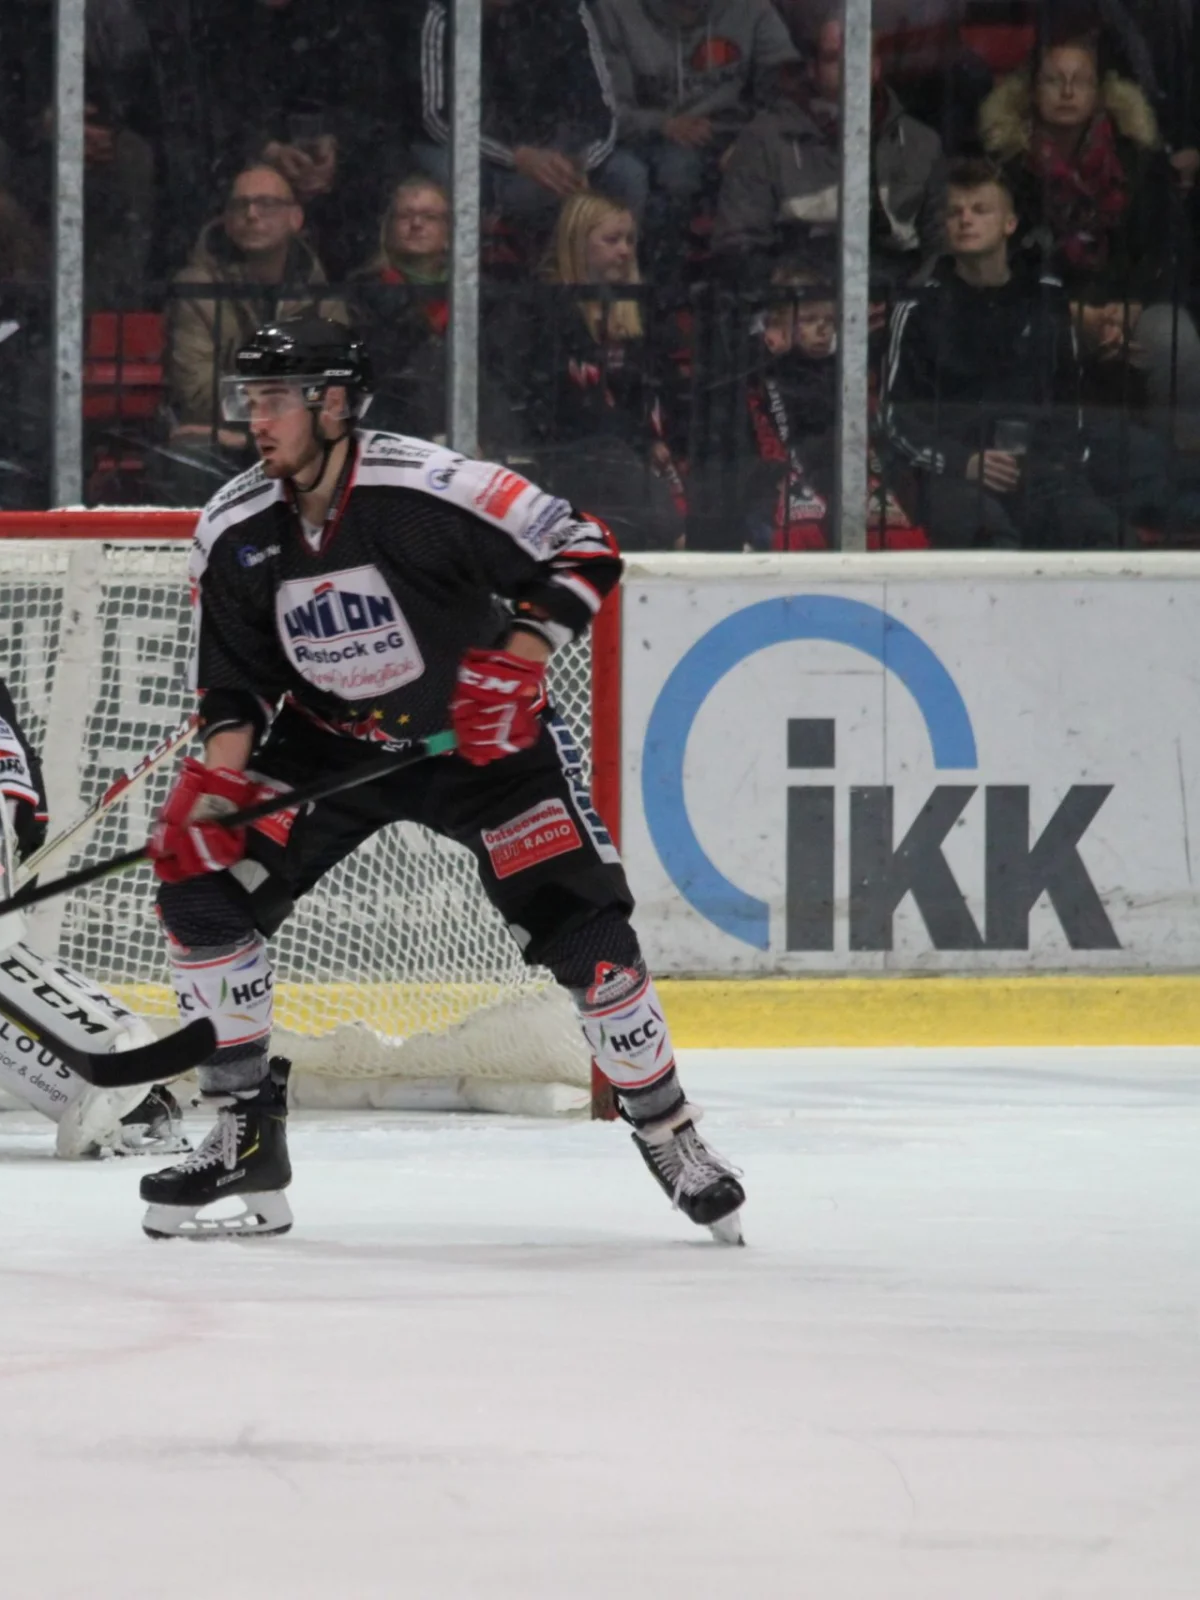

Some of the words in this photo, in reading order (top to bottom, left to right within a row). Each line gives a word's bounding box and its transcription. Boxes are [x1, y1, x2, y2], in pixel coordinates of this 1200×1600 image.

[284, 589, 397, 639] UNION
[373, 631, 405, 654] eG
[0, 955, 110, 1036] CCM
[609, 1019, 659, 1054] HCC
[17, 1065, 28, 1080] &
[29, 1071, 69, 1105] design
